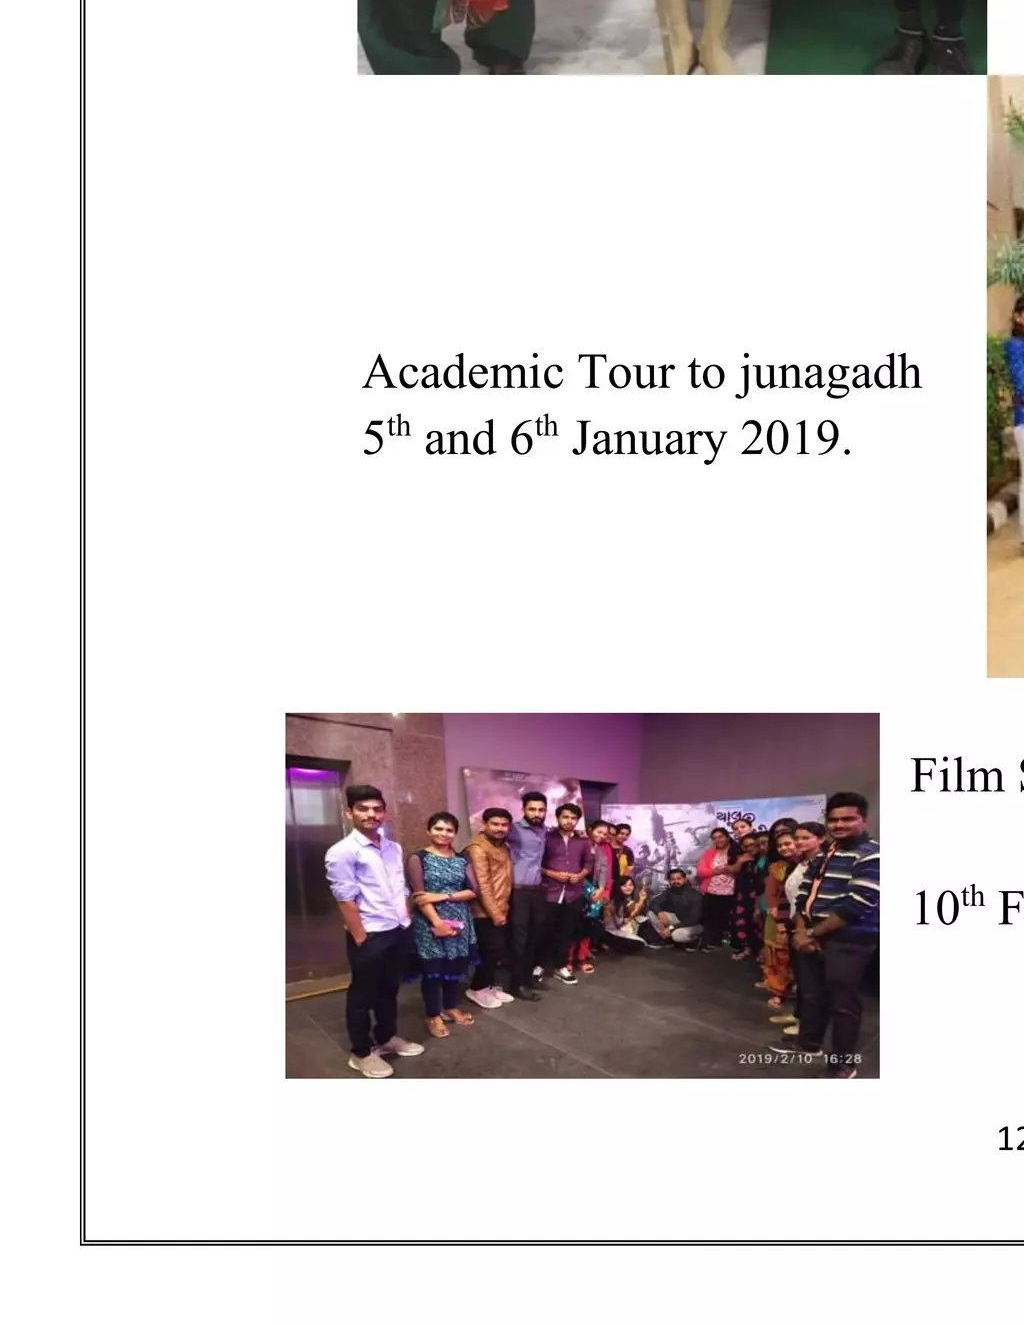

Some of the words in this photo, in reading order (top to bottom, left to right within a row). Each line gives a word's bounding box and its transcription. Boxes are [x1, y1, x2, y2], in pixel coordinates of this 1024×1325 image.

[362, 353, 563, 388] Academic
[579, 354, 675, 388] Tour
[688, 358, 725, 388] to
[735, 353, 922, 399] junagadh
[364, 414, 411, 455] 5th
[426, 419, 496, 455] and
[511, 414, 558, 455] 6th
[573, 421, 727, 465] January
[741, 420, 851, 455] 2019.
[911, 756, 1005, 792] Film
[916, 884, 985, 925] 10th
